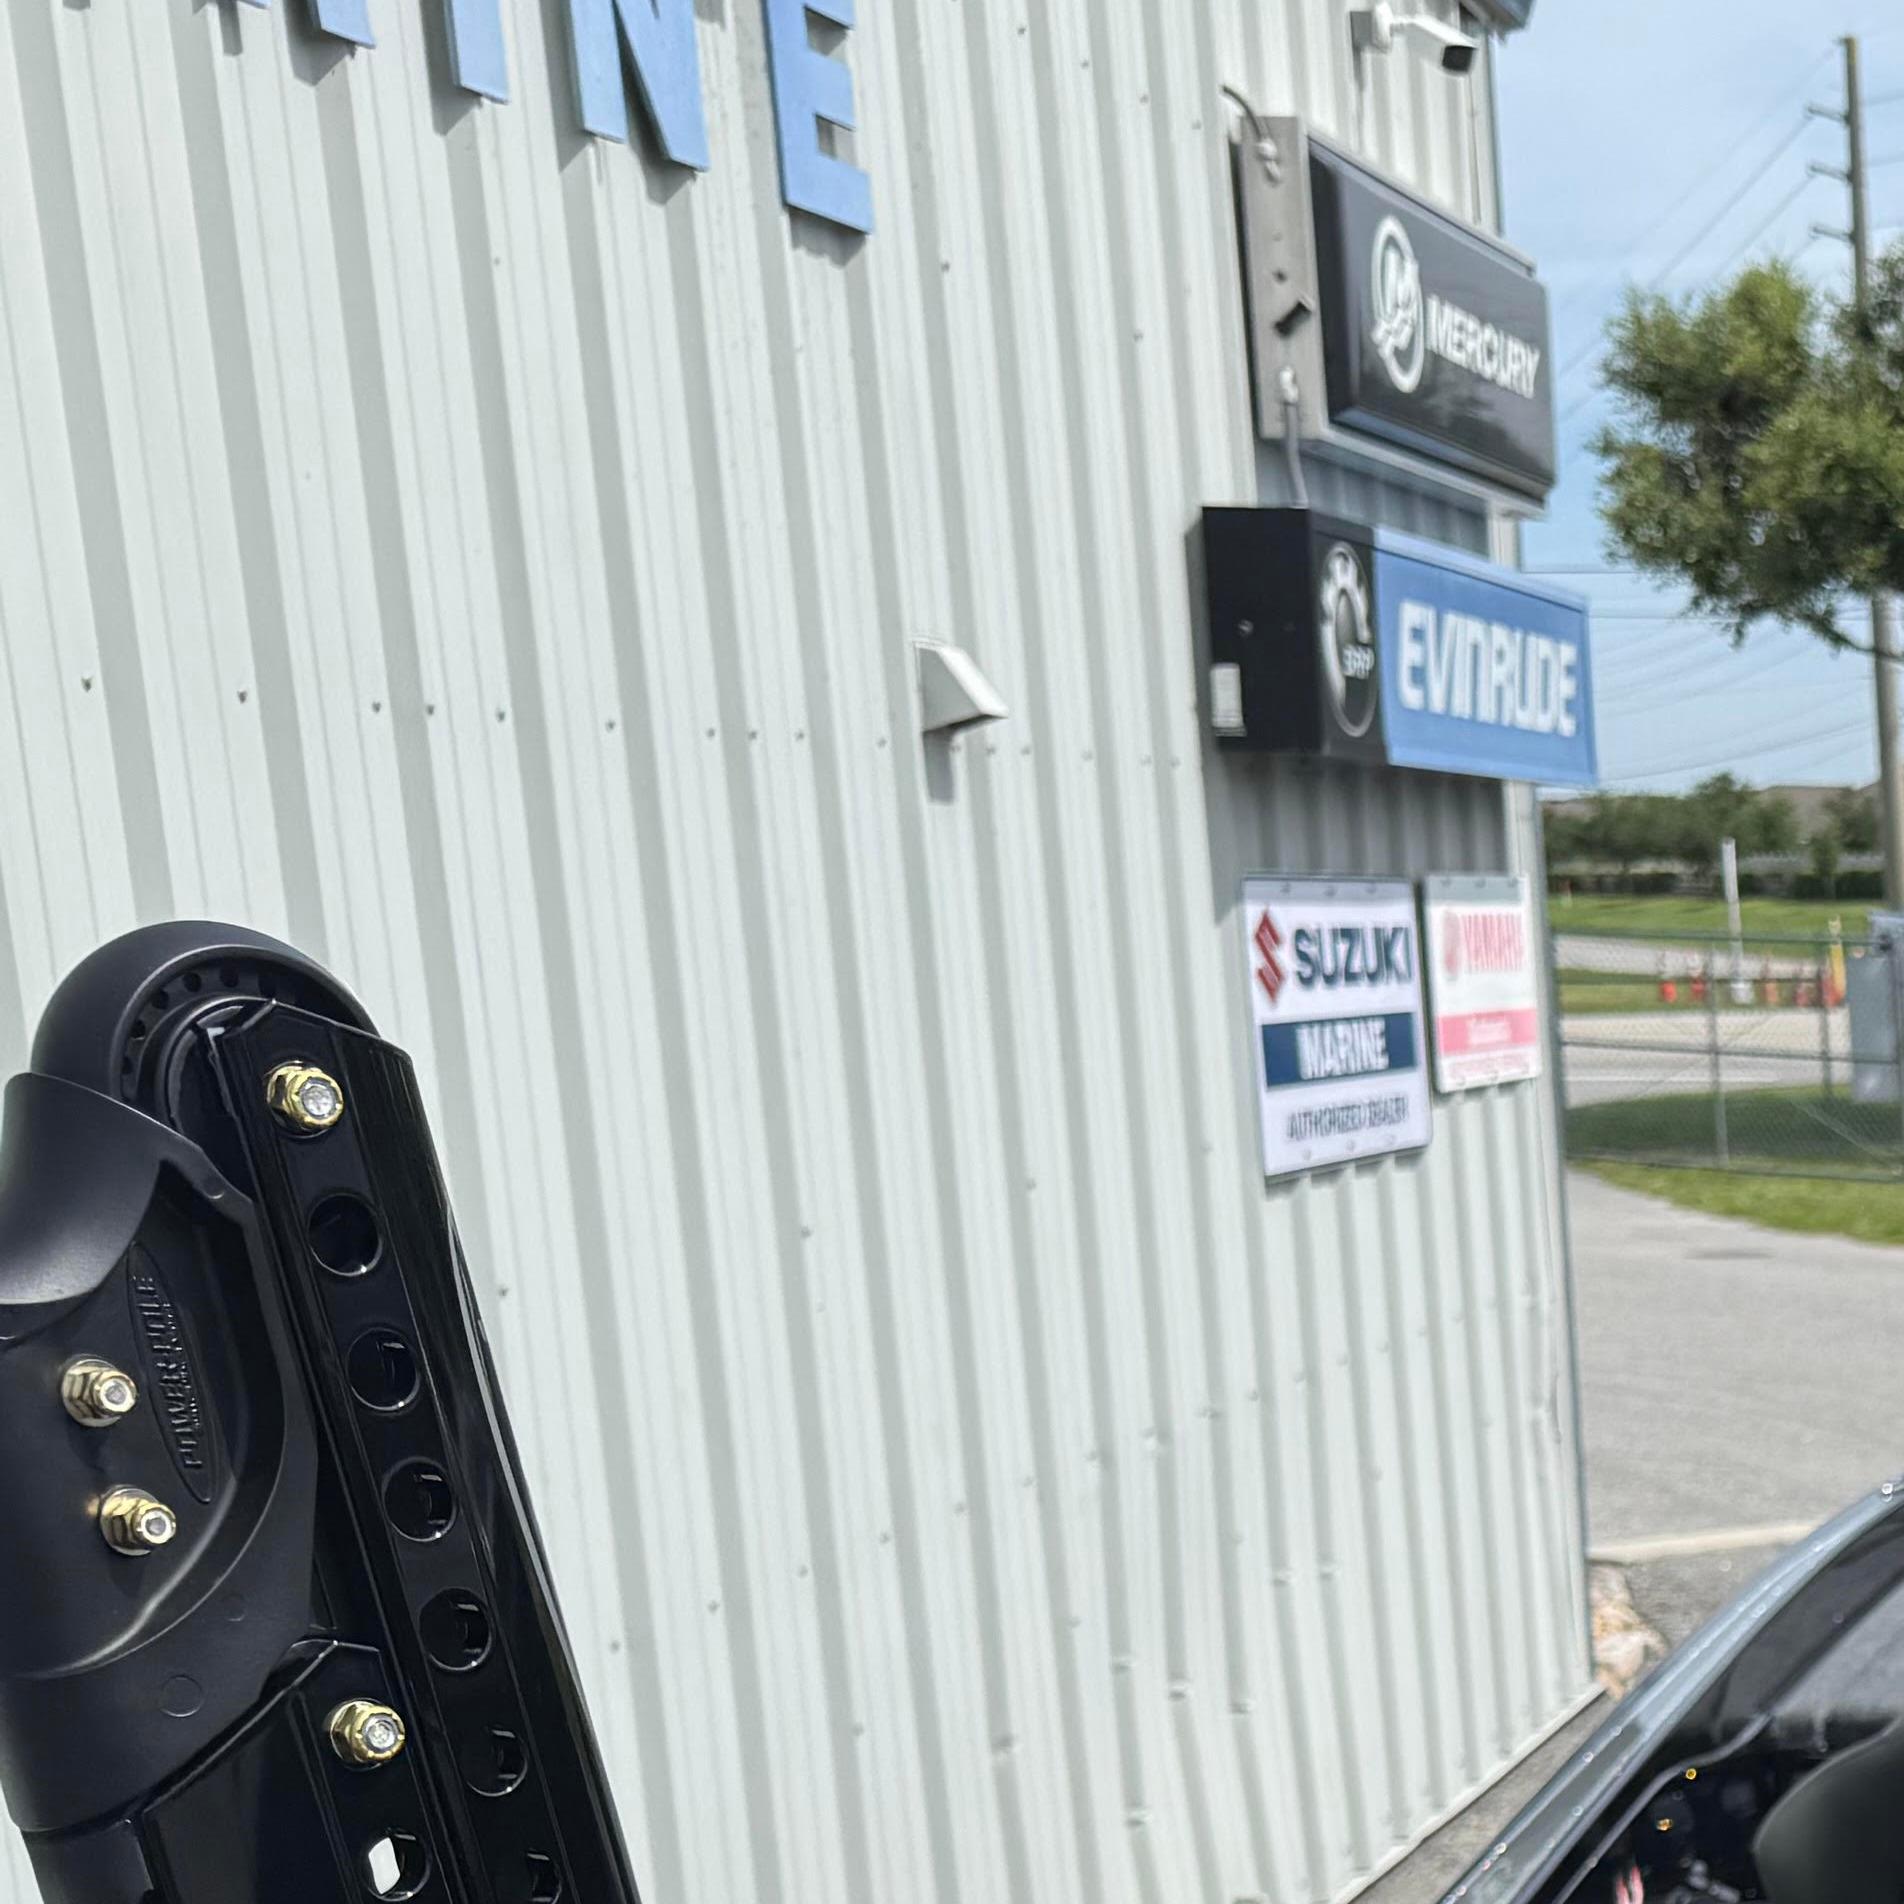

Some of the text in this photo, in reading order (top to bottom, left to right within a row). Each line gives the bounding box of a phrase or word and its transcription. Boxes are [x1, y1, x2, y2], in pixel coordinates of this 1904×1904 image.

[1424, 294, 1541, 399] MERCURY
[1400, 599, 1577, 738] EVINRUDE
[1294, 925, 1412, 986] SUZUKI
[1296, 1016, 1390, 1081] MARINE
